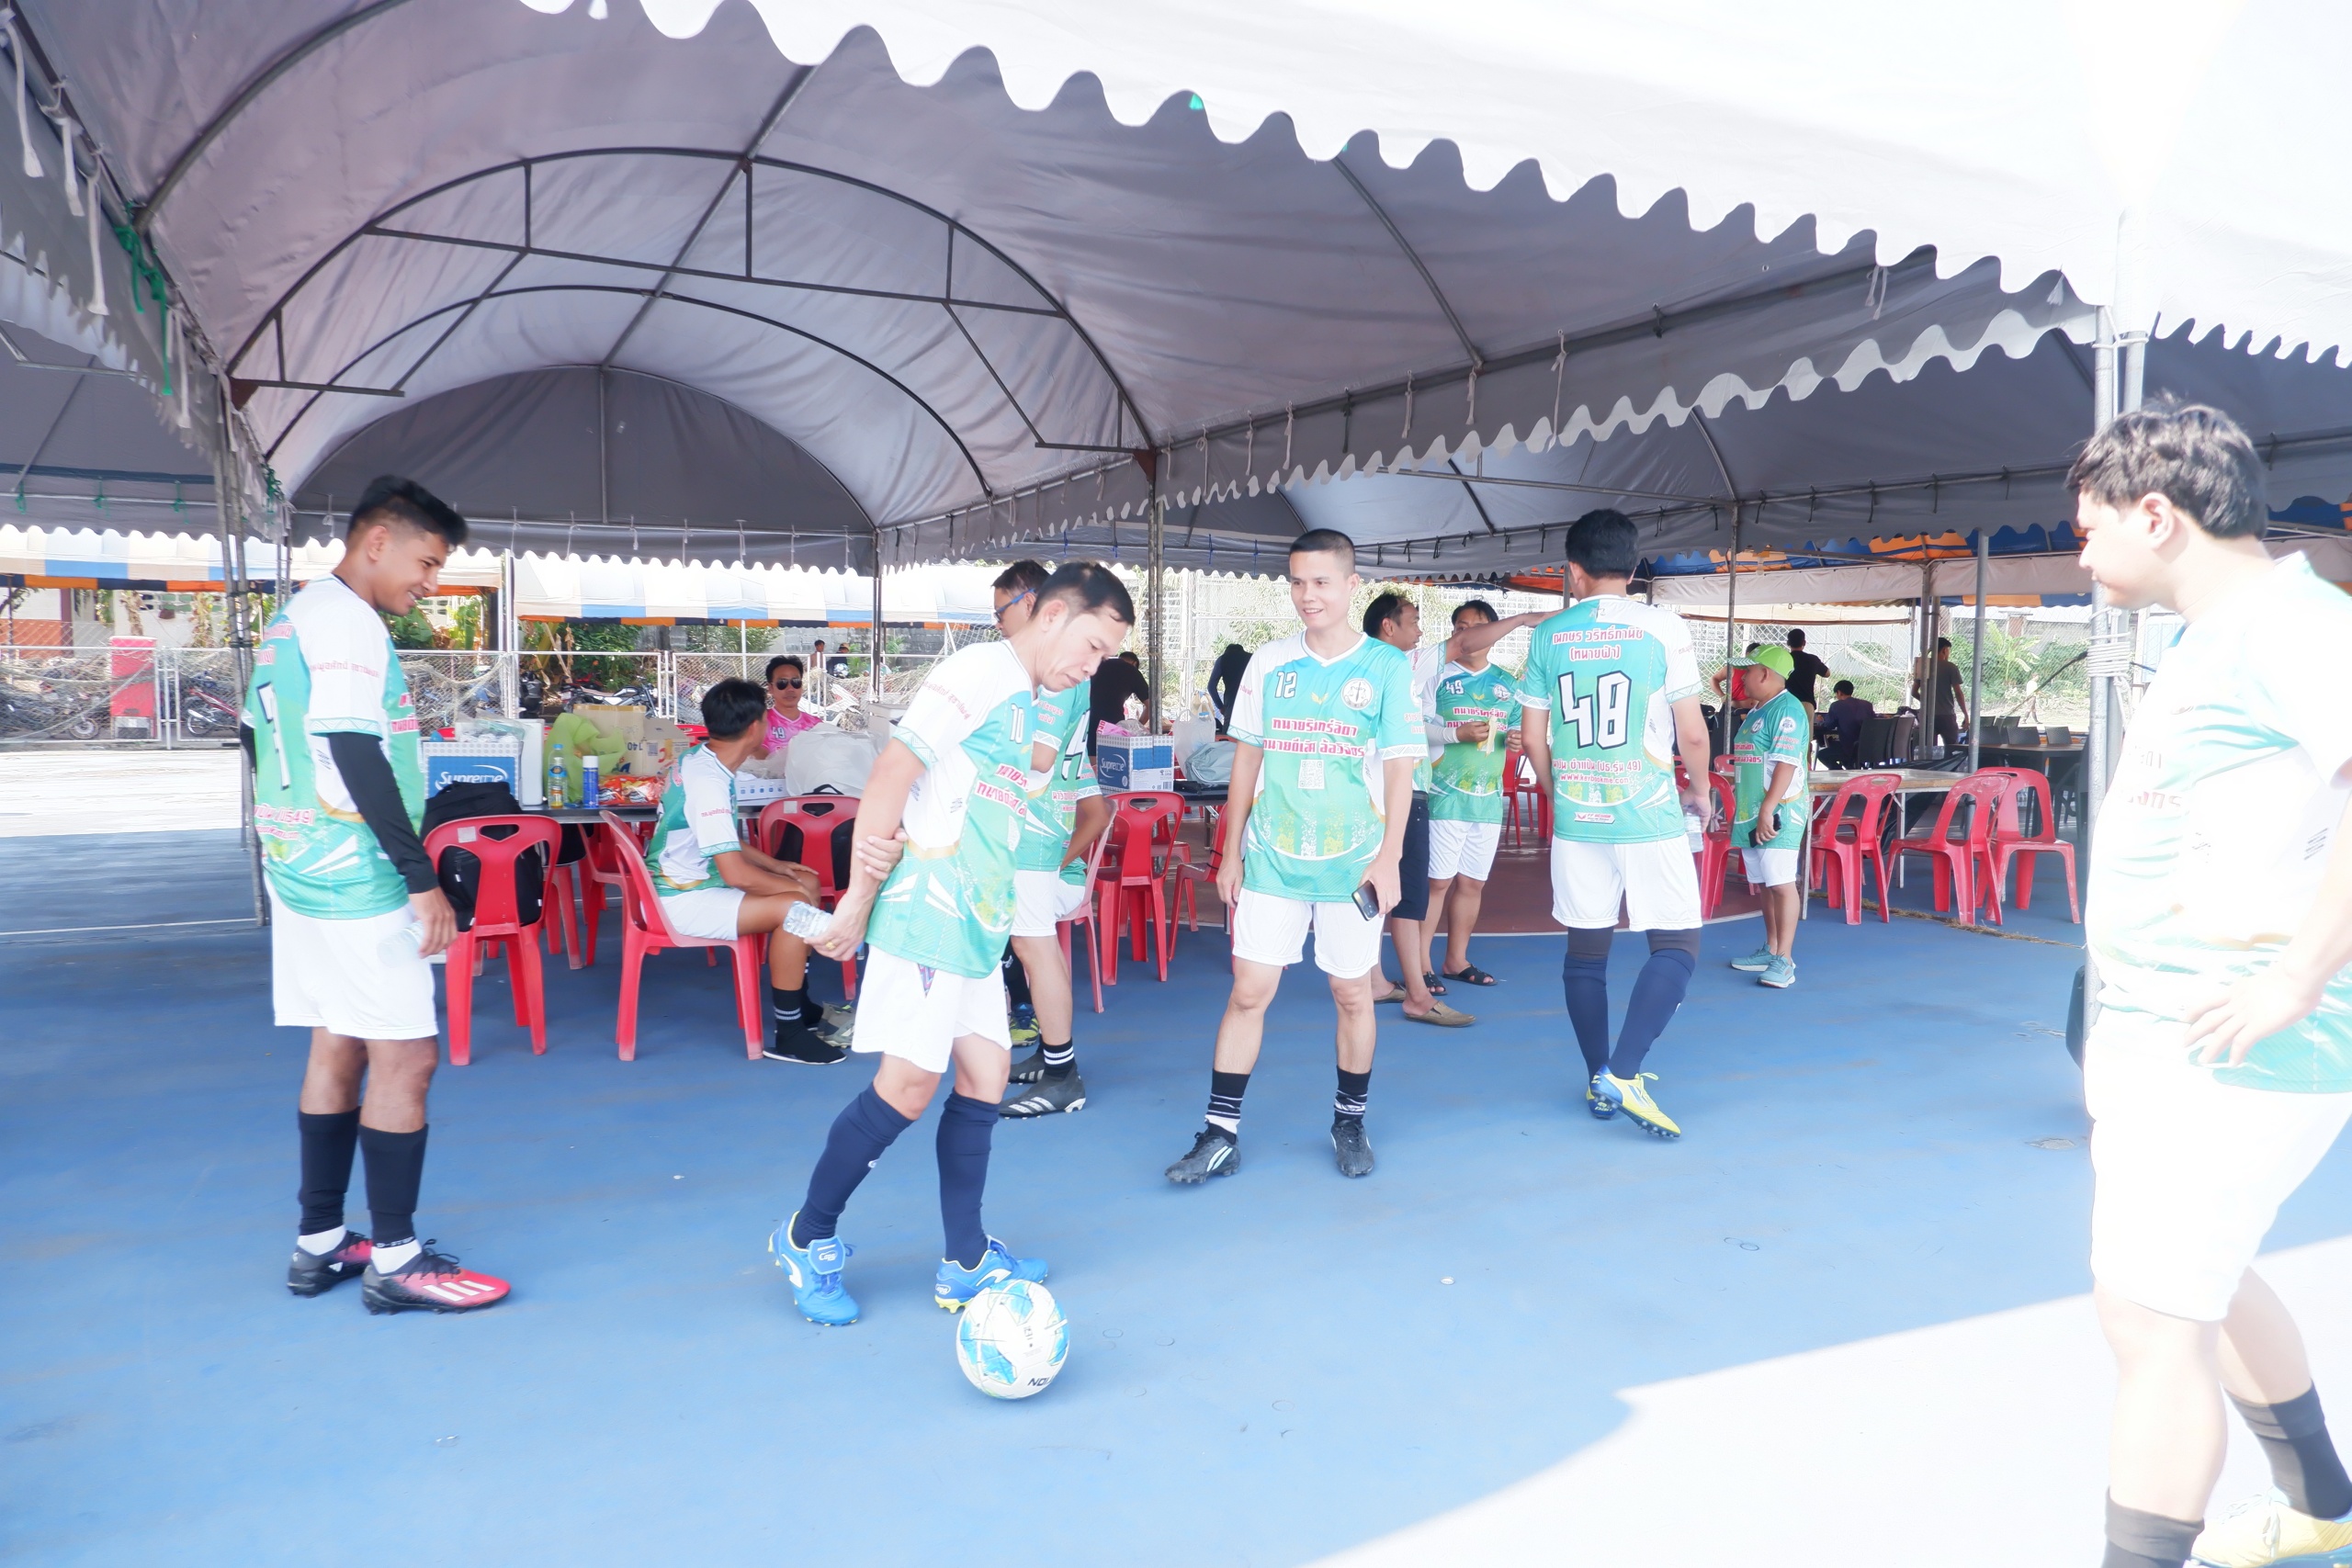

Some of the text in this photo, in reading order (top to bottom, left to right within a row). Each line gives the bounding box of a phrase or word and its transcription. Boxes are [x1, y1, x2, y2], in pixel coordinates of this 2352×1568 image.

[1274, 671, 1297, 699] 12
[1445, 680, 1464, 694] 49
[1557, 670, 1632, 750] 48
[772, 727, 786, 739] 49
